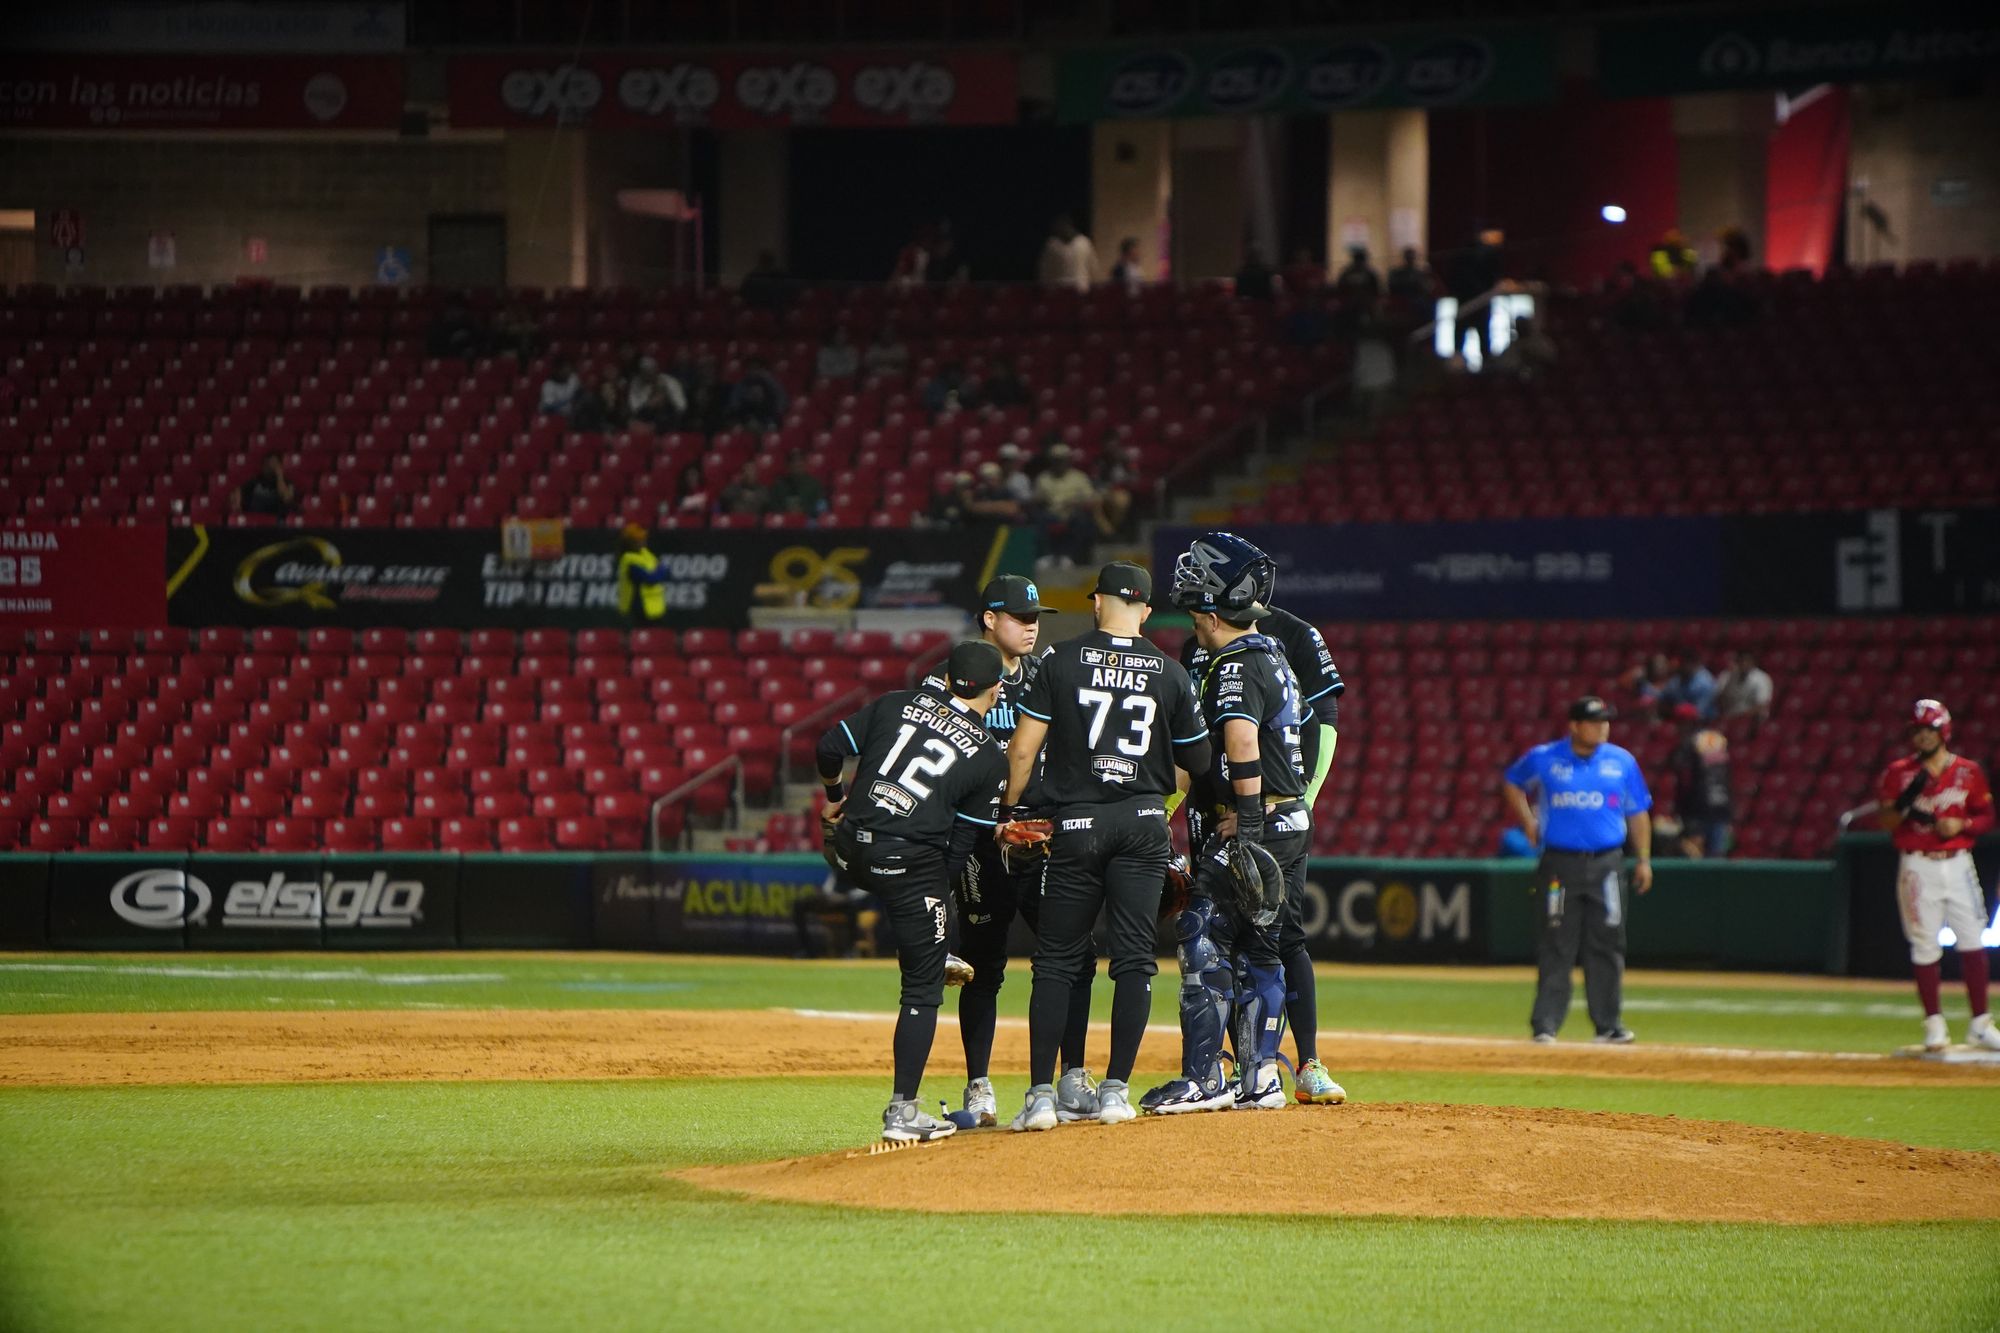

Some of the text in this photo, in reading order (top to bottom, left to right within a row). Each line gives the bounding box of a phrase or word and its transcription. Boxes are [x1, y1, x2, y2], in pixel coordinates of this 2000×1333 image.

[69, 73, 116, 105] las
[128, 73, 261, 106] noticias
[545, 581, 583, 608] DE
[1125, 656, 1160, 669] BBVA
[1091, 668, 1149, 692] ARIAS
[901, 704, 980, 759] SEPULVEDA
[951, 716, 984, 740] BBVA
[1078, 689, 1158, 756] 73
[877, 723, 959, 800] 12
[1061, 817, 1095, 831] TECATE
[934, 906, 946, 944] Vector
